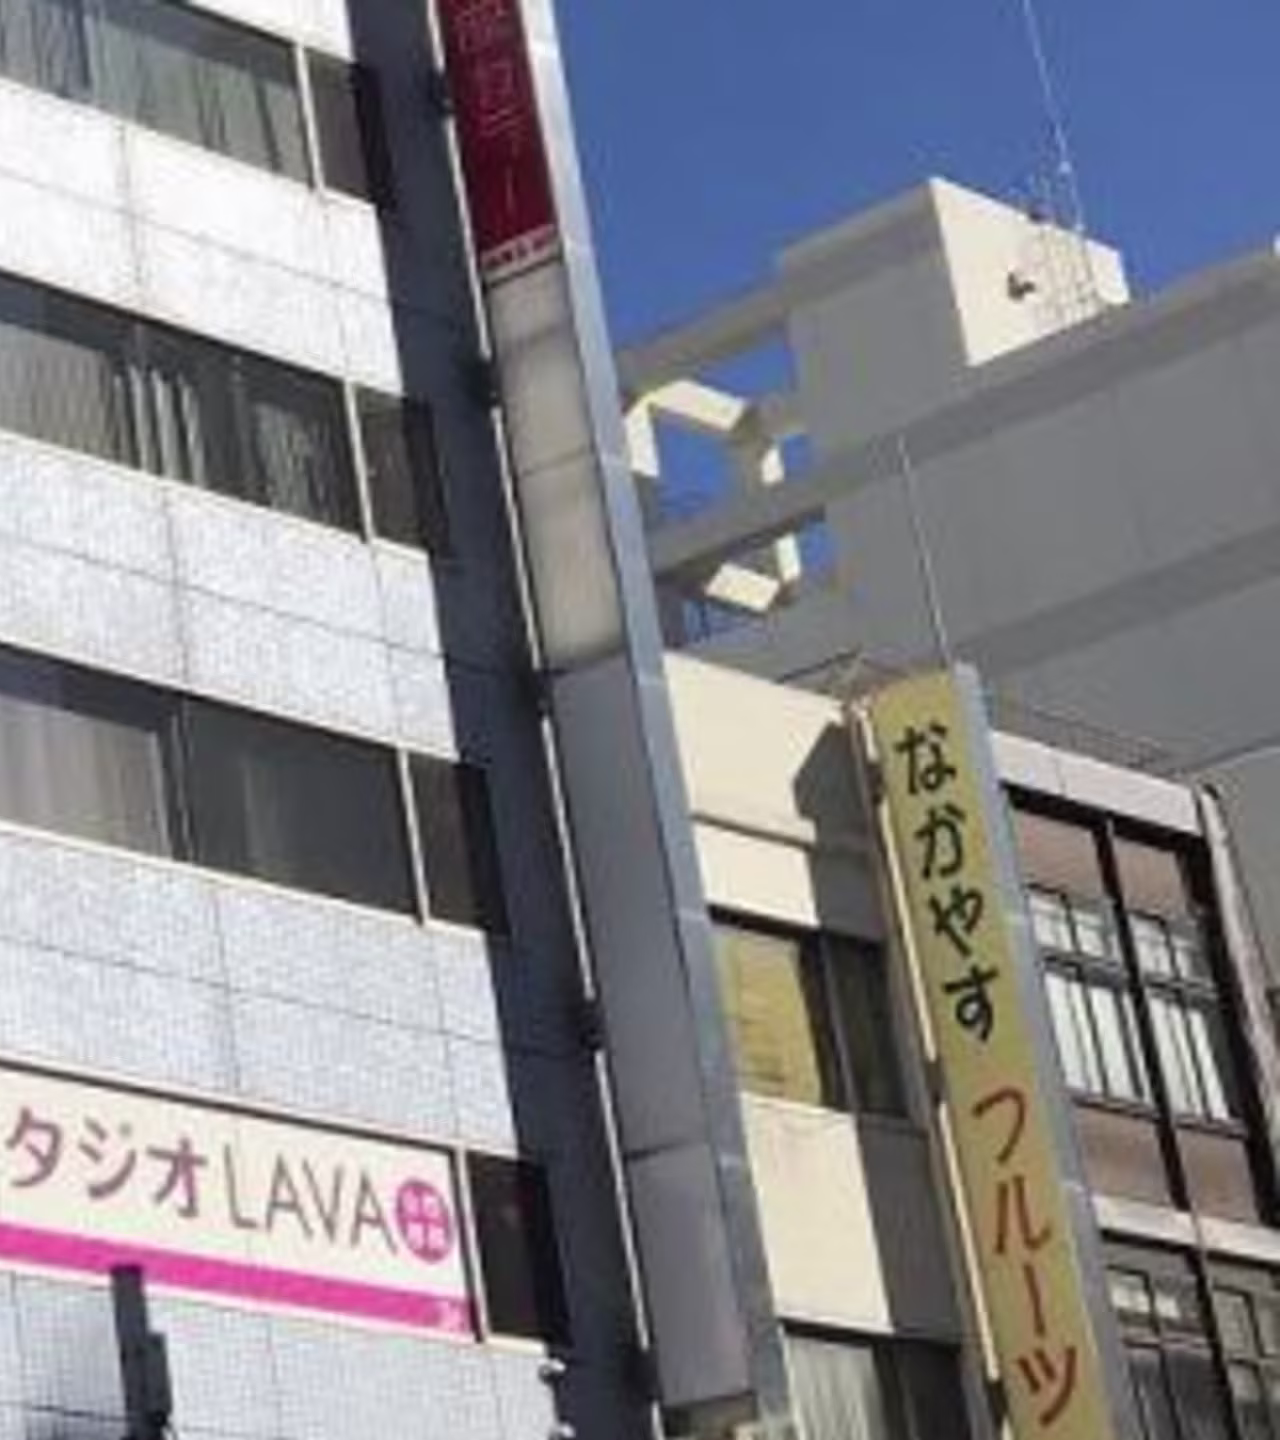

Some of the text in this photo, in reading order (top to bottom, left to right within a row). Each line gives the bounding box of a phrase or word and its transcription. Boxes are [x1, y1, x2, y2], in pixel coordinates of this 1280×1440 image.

[894, 723, 999, 1043] なかやす
[972, 1087, 1078, 1426] フルーツ
